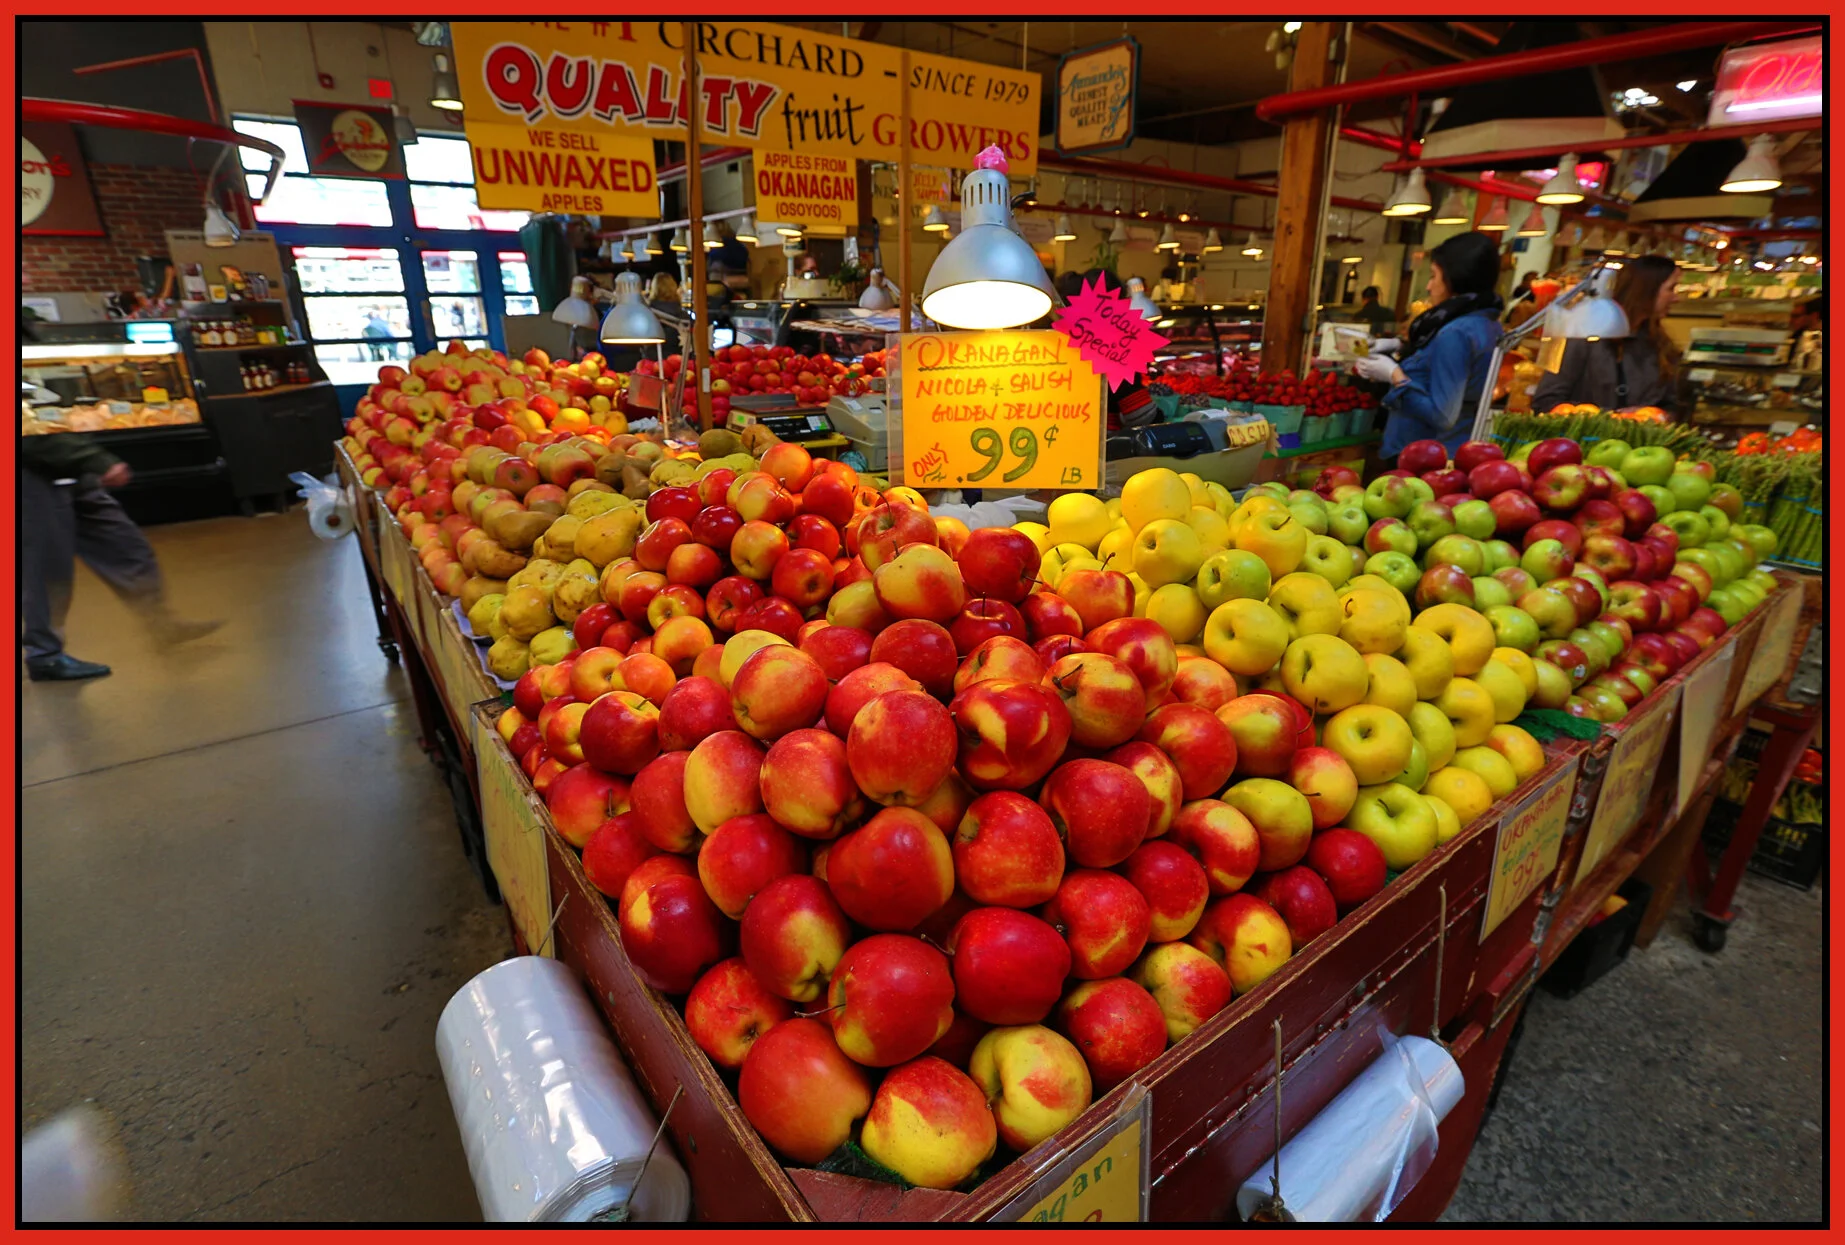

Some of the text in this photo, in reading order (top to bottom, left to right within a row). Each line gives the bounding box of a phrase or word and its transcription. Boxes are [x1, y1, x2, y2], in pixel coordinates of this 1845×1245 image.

[658, 22, 864, 78] ORCHARD
[910, 65, 976, 97] SINCE
[985, 78, 1030, 106] 1979
[482, 42, 782, 140] QUALITY
[780, 90, 865, 150] fruit
[872, 112, 1031, 162] GROWERS
[528, 129, 599, 153] WE SELL
[475, 147, 653, 193] UNWAXED
[764, 152, 847, 173] APPLES FROM
[541, 193, 604, 212] APPLES
[758, 169, 855, 201] OKANAGAN
[775, 202, 841, 221] (OSOYOOS)
[1095, 294, 1140, 348] Today
[907, 335, 1061, 369] OKANAGAN
[1068, 317, 1131, 366] Special
[915, 377, 988, 399] NICOLA
[1009, 369, 1073, 394] SALISH
[931, 402, 1091, 423] GOLDEN DELICIOUS
[912, 442, 949, 478] ONLY
[1060, 466, 1082, 485] LB
